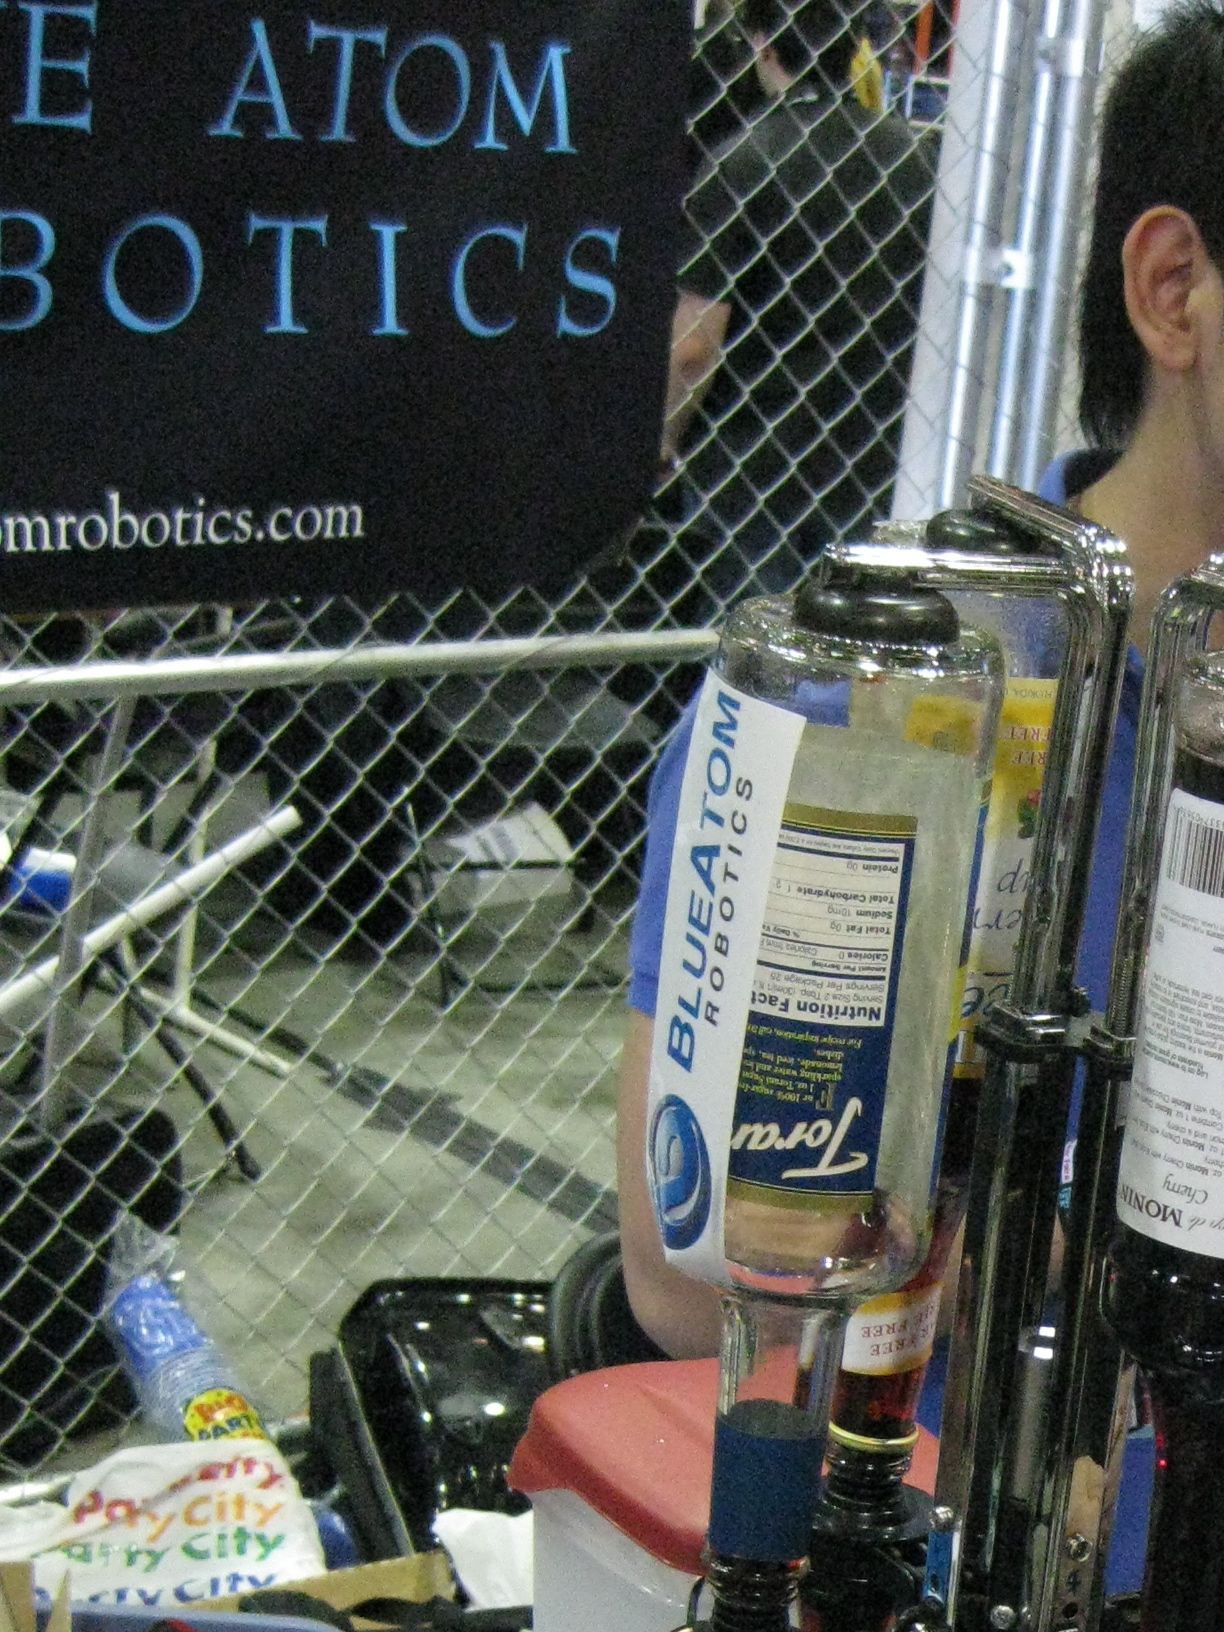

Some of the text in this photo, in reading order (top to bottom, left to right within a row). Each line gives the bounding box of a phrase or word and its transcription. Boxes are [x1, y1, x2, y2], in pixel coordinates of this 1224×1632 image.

[208, 17, 578, 154] ATOM
[0, 489, 365, 555] mrobotics.com
[667, 689, 742, 1073] BLUEATOM
[861, 861, 898, 874] Protein
[704, 775, 753, 1027] ROBOTICS
[795, 885, 895, 905] Total Carbohydrate
[845, 923, 863, 935] Fat
[855, 907, 893, 921] Sodium
[864, 924, 891, 937] Total
[846, 948, 888, 964] Calories
[825, 980, 842, 991] Per
[844, 979, 884, 996] Servings
[749, 991, 881, 1024] Nutrition Fact
[730, 1096, 869, 1180] Tora
[1162, 1173, 1209, 1205] Cherry
[1120, 1184, 1184, 1229] MONIN
[182, 1491, 284, 1528] City
[181, 1526, 287, 1562] City
